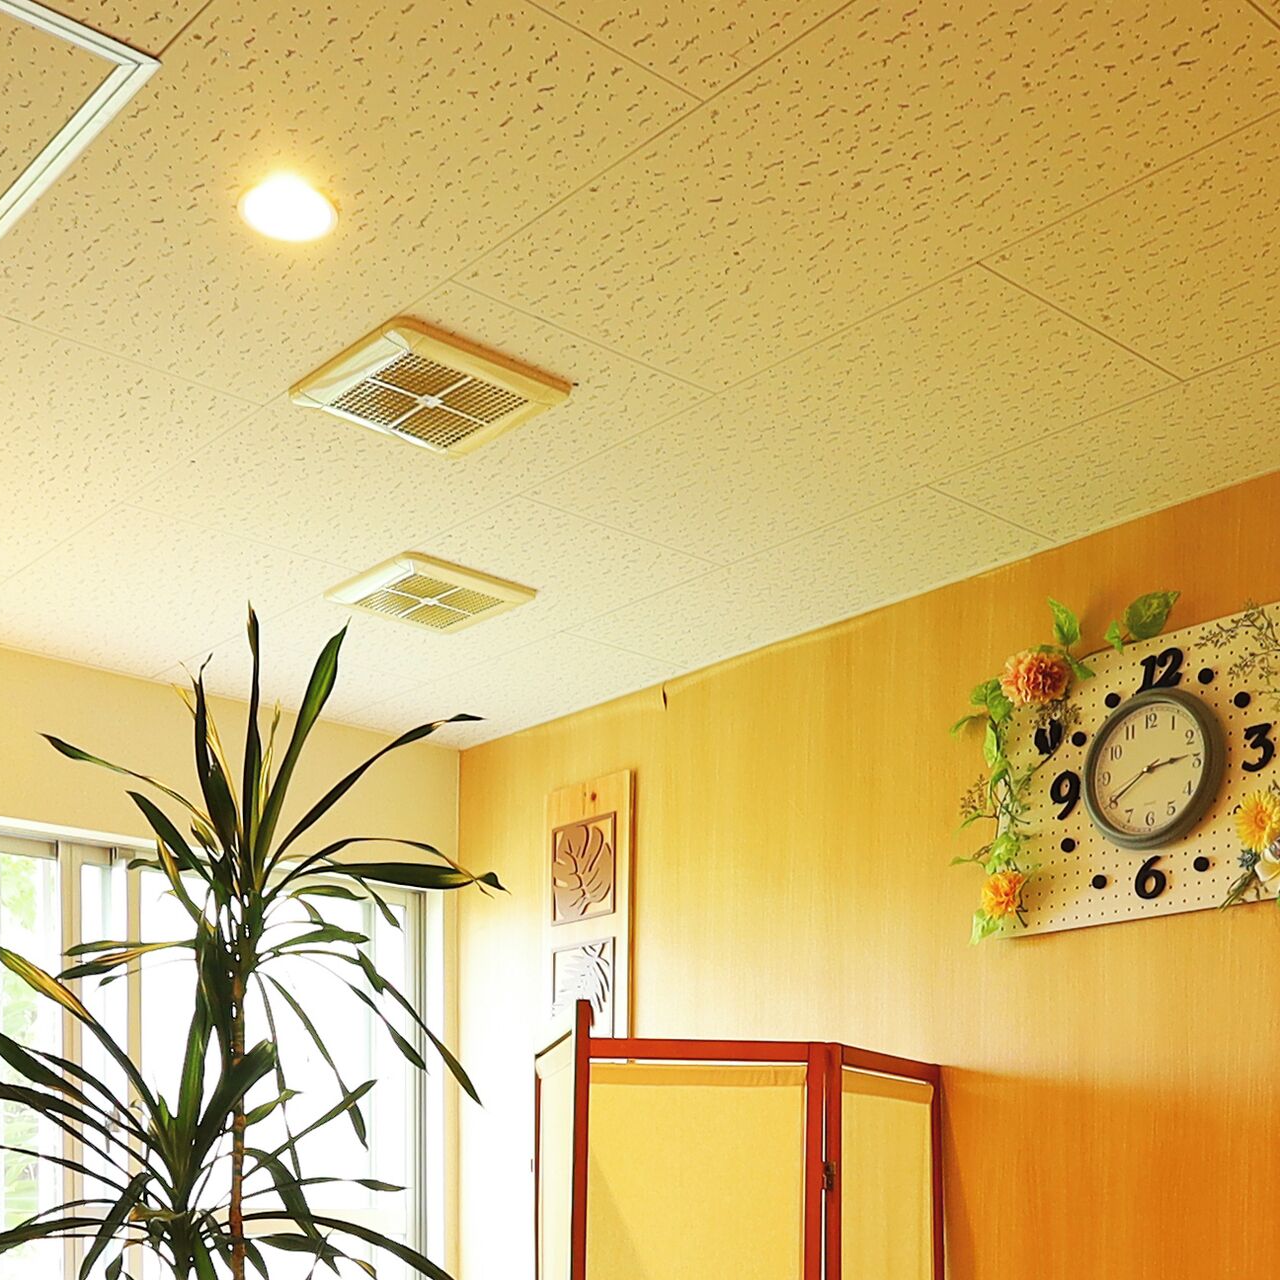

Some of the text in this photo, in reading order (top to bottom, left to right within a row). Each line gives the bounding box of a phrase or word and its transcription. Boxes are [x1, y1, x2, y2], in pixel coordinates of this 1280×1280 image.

[1136, 647, 1184, 694] 12
[1145, 713, 1159, 729] 12
[1125, 725, 1136, 741] 11
[1185, 729, 1195, 745] 2
[1110, 745, 1122, 761] 10
[1242, 723, 1276, 773] 3
[1102, 771, 1111, 786] 9
[1050, 770, 1081, 820] 9
[1183, 780, 1194, 796] 4
[1125, 808, 1134, 823] 7
[1166, 800, 1176, 816] 5
[1145, 811, 1155, 826] 6
[1134, 855, 1166, 900] 6
